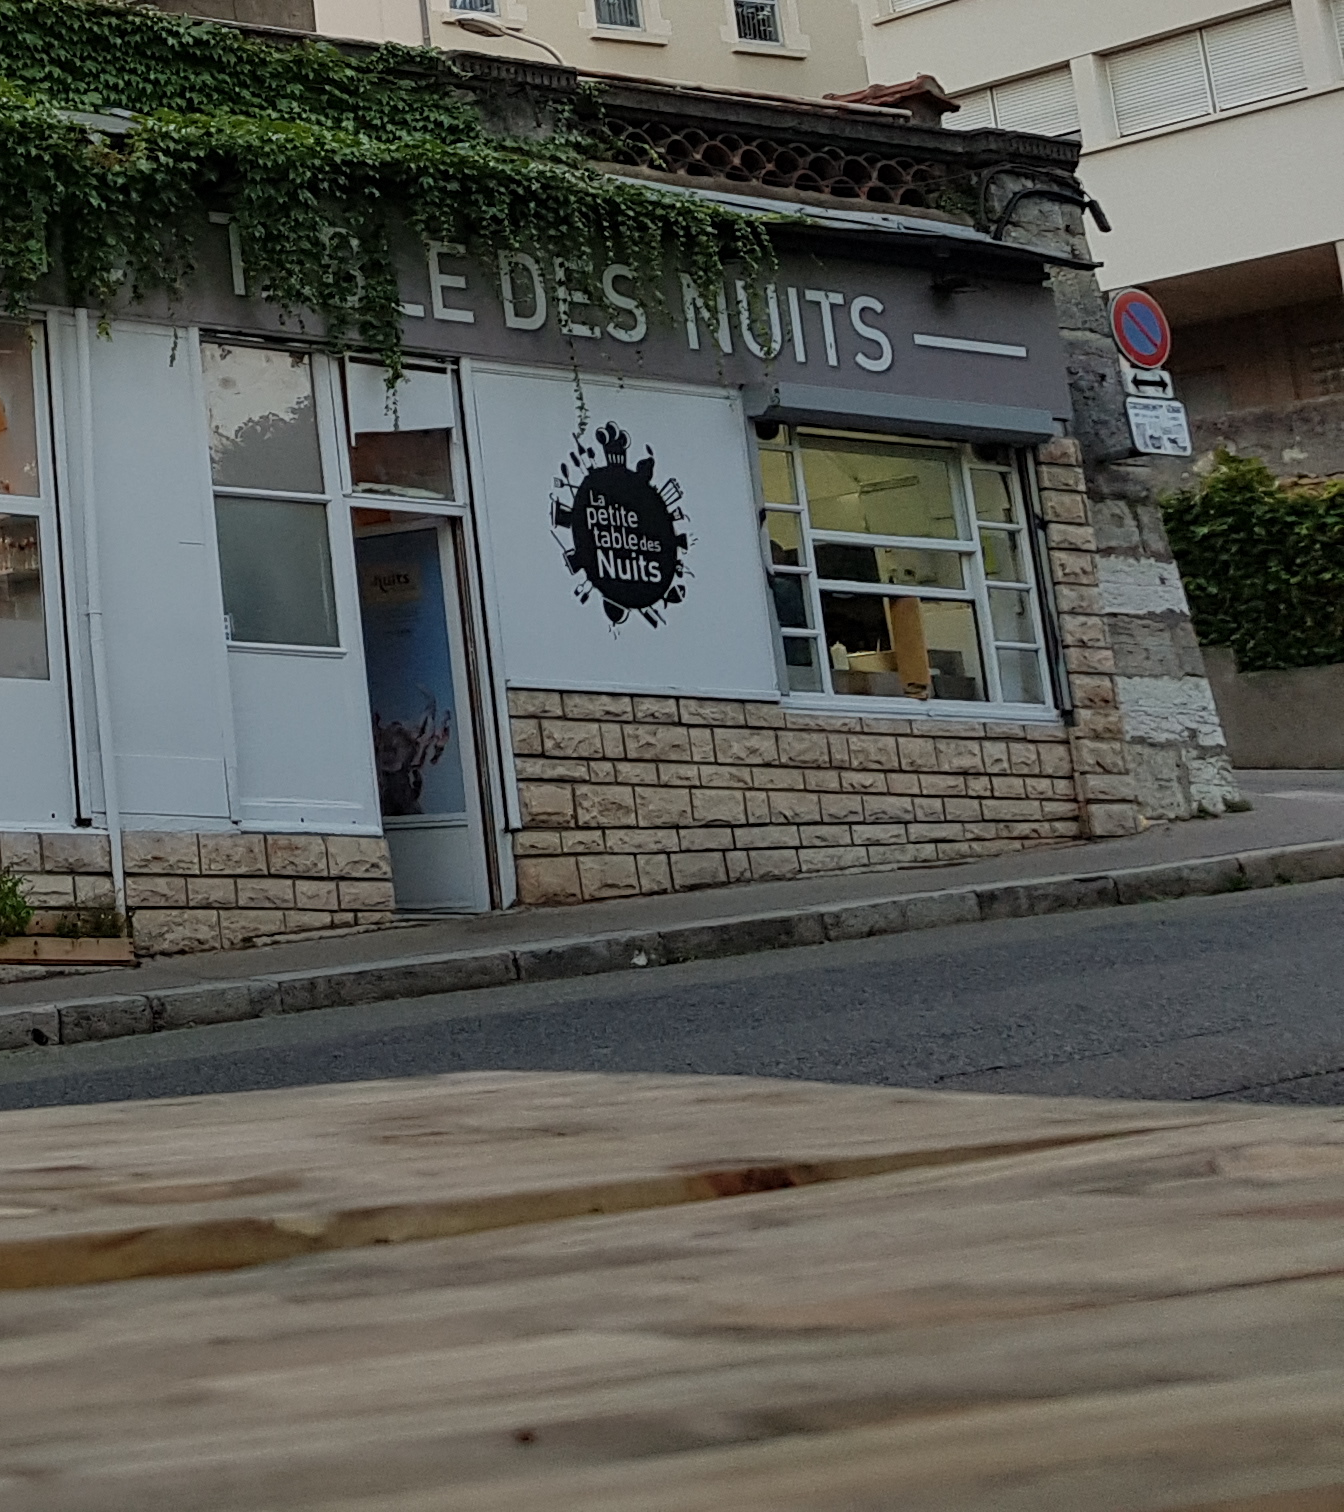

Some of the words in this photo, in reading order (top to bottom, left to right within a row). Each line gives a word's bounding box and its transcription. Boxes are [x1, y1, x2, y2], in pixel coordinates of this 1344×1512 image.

[497, 248, 648, 343] DES
[681, 272, 894, 373] NUITS
[590, 490, 605, 506] La
[586, 504, 638, 529] petite
[594, 526, 638, 550] table
[639, 536, 661, 552] des
[597, 549, 662, 582] Nuits
